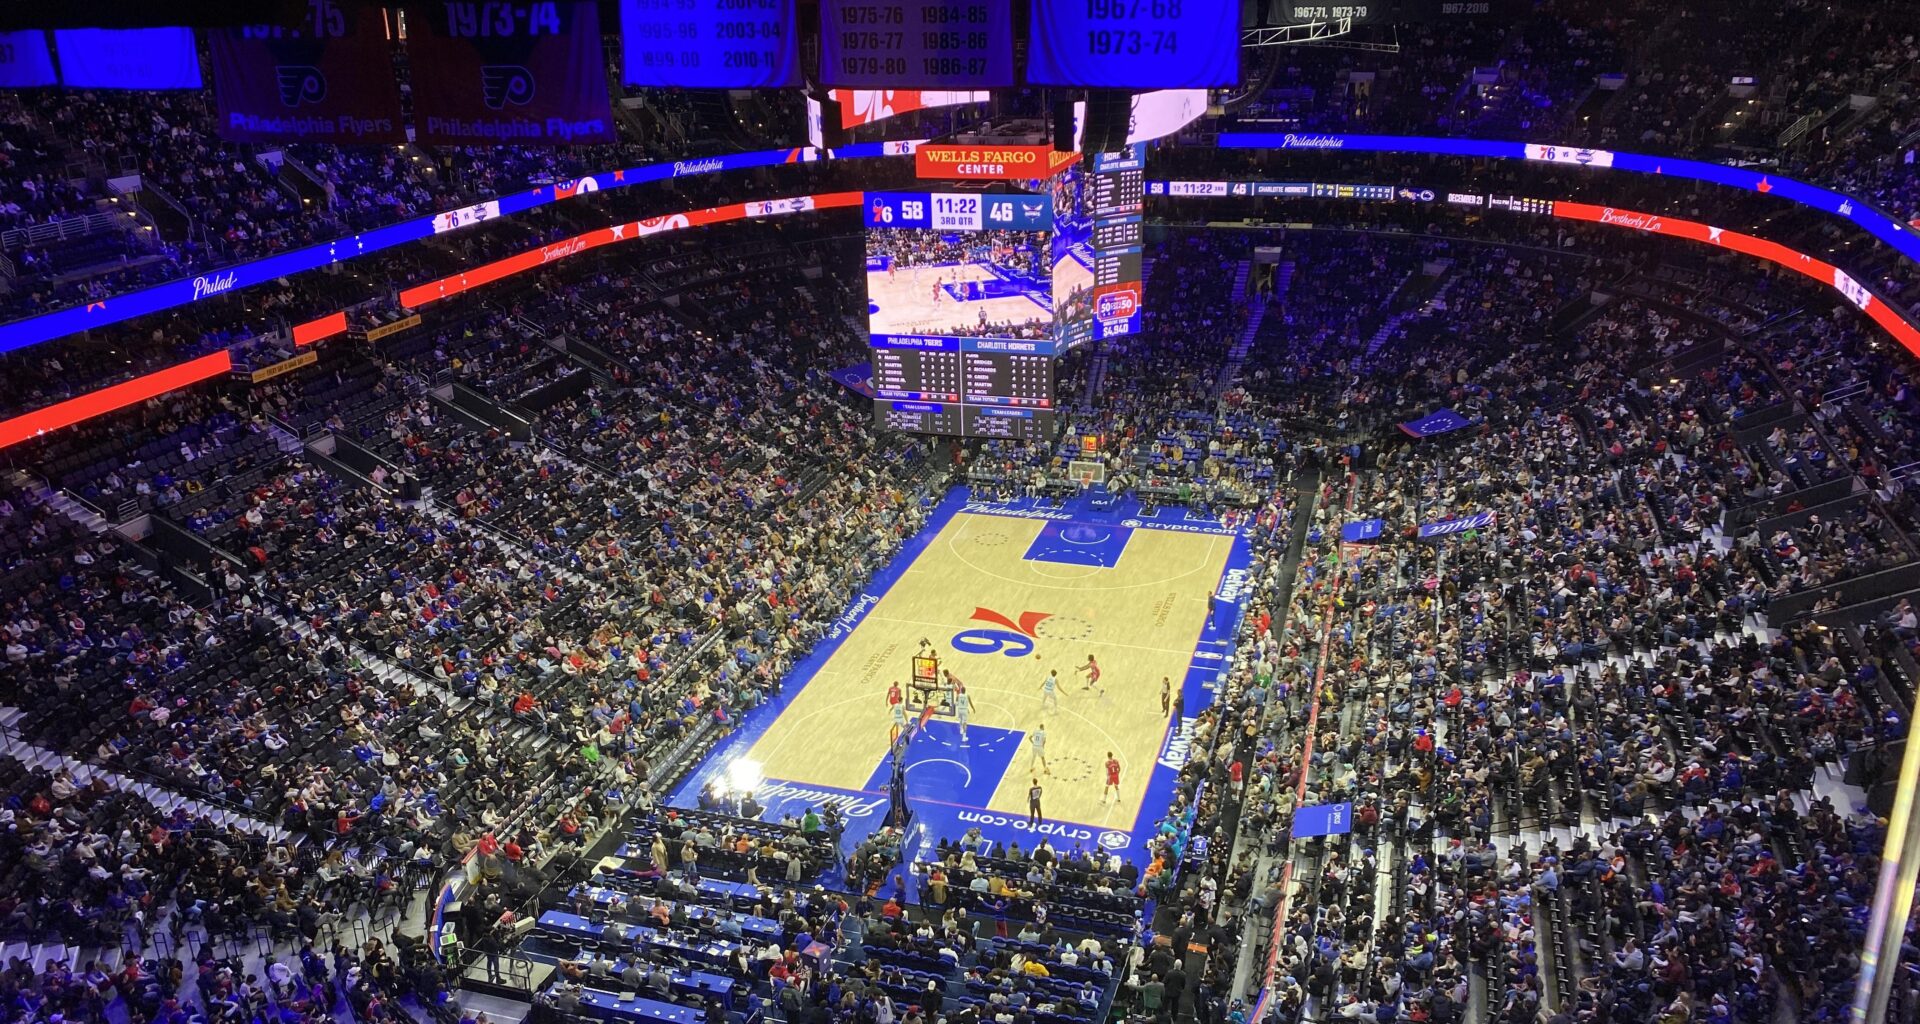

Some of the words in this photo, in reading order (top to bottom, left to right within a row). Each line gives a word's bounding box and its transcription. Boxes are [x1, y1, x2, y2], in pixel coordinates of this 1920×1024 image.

[840, 6, 904, 25] 1975-76
[921, 6, 987, 25] 1984-85
[1087, 0, 1182, 20] 1967-68
[1294, 7, 1329, 19] 1967-71,
[1332, 6, 1367, 17] 1973-79
[715, 22, 781, 40] 2003-04
[840, 31, 904, 50] 1976-77
[922, 31, 987, 50] 1985-86
[1087, 29, 1178, 55] 1973-74
[723, 51, 776, 69] 2010-11
[840, 57, 907, 75] 1979-80
[922, 57, 987, 75] 1986-87
[229, 113, 335, 135] Philadelphia
[338, 115, 393, 138] Flyers
[426, 117, 542, 138] Philadelphia
[545, 117, 604, 138] Flyers
[893, 141, 910, 154] 76
[1281, 133, 1344, 148] Philadelphia
[926, 150, 980, 163] WELLS
[983, 151, 1036, 164] FARGO
[1539, 146, 1556, 161] 76
[672, 157, 724, 178] Philadelphia
[957, 164, 1004, 174] CENTER
[1150, 183, 1164, 194] 58
[1183, 183, 1213, 194] 11:22
[1232, 183, 1247, 194] 46
[1447, 193, 1476, 204] DECEMBER
[1476, 195, 1484, 205] 21
[757, 201, 773, 216] 76
[872, 206, 893, 223] 76
[901, 201, 924, 220] 58
[936, 198, 977, 214] 11:22
[989, 202, 1013, 221] 46
[444, 210, 459, 230] 76
[940, 216, 956, 225] 3RD
[958, 217, 973, 226] QTR
[1600, 207, 1645, 229] Brotherly
[540, 242, 571, 264] Brotherly
[887, 336, 923, 346] PHILADELPHIA
[924, 338, 943, 347] 76ERS
[977, 341, 1007, 350] CHARLOTTE
[1008, 342, 1035, 351] HORNETS
[958, 503, 1074, 520] Philadelphia
[1146, 521, 1238, 535] crypto.com
[1214, 568, 1246, 604] betway
[841, 593, 879, 623] Brotherly
[951, 606, 1055, 658] 76
[958, 810, 1093, 840] crypto.com
